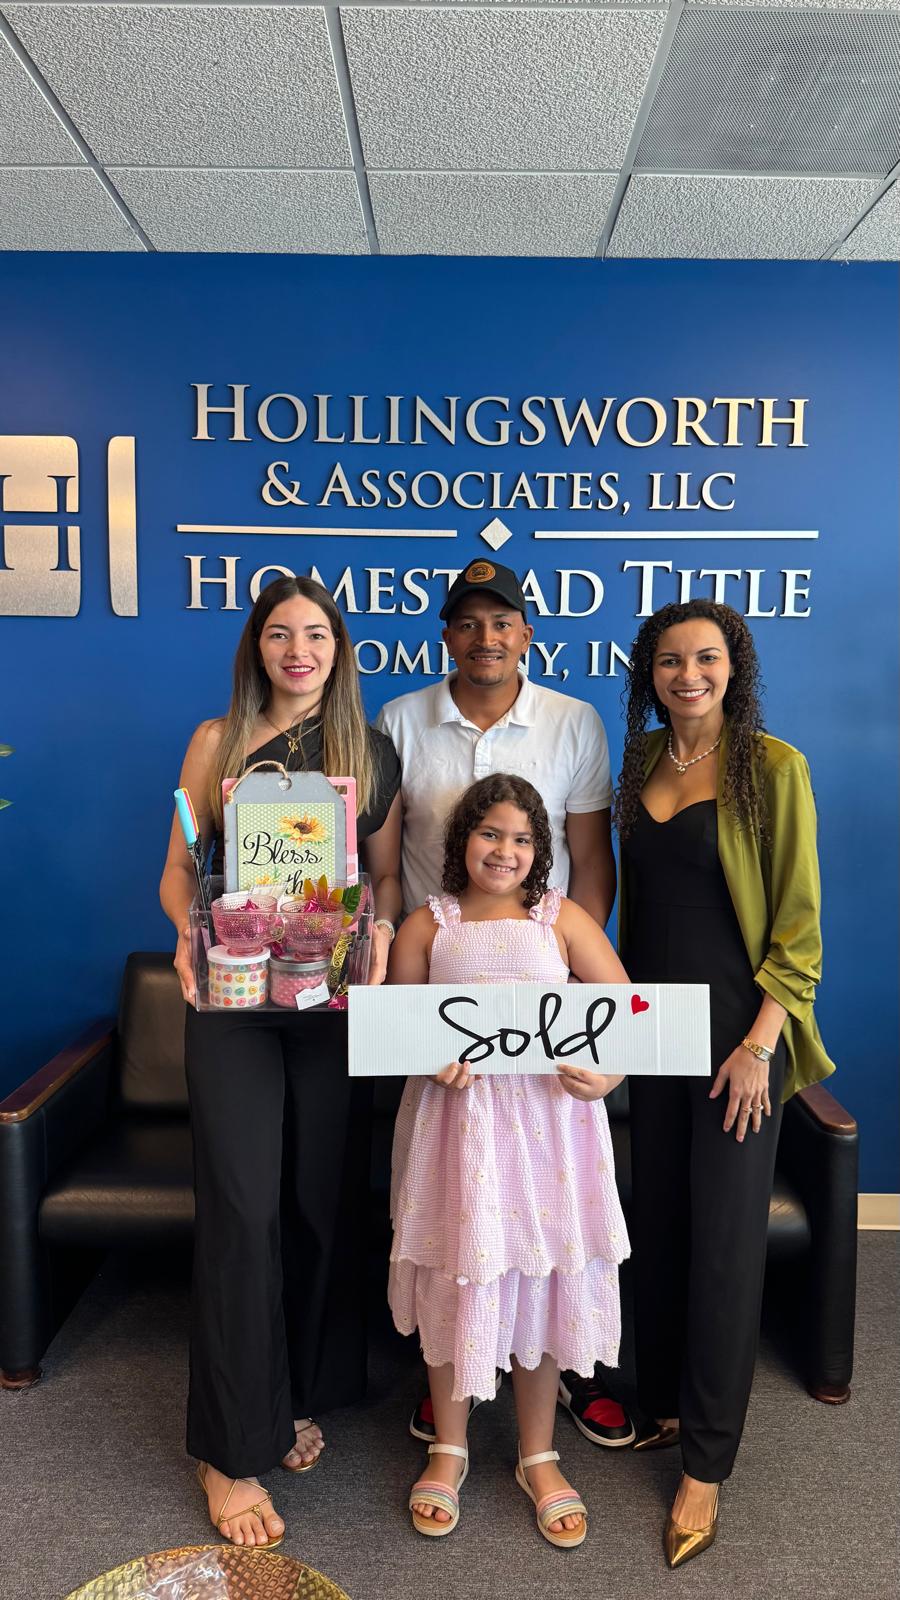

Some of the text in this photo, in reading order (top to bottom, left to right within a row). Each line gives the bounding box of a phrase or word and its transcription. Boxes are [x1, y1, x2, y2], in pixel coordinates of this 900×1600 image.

[190, 383, 809, 448] HOLLINGSWORTH
[261, 461, 736, 516] & ASSOCIATES, LLC
[623, 560, 812, 618] TITLE
[242, 831, 323, 866] Bless
[438, 992, 617, 1065] Sold
